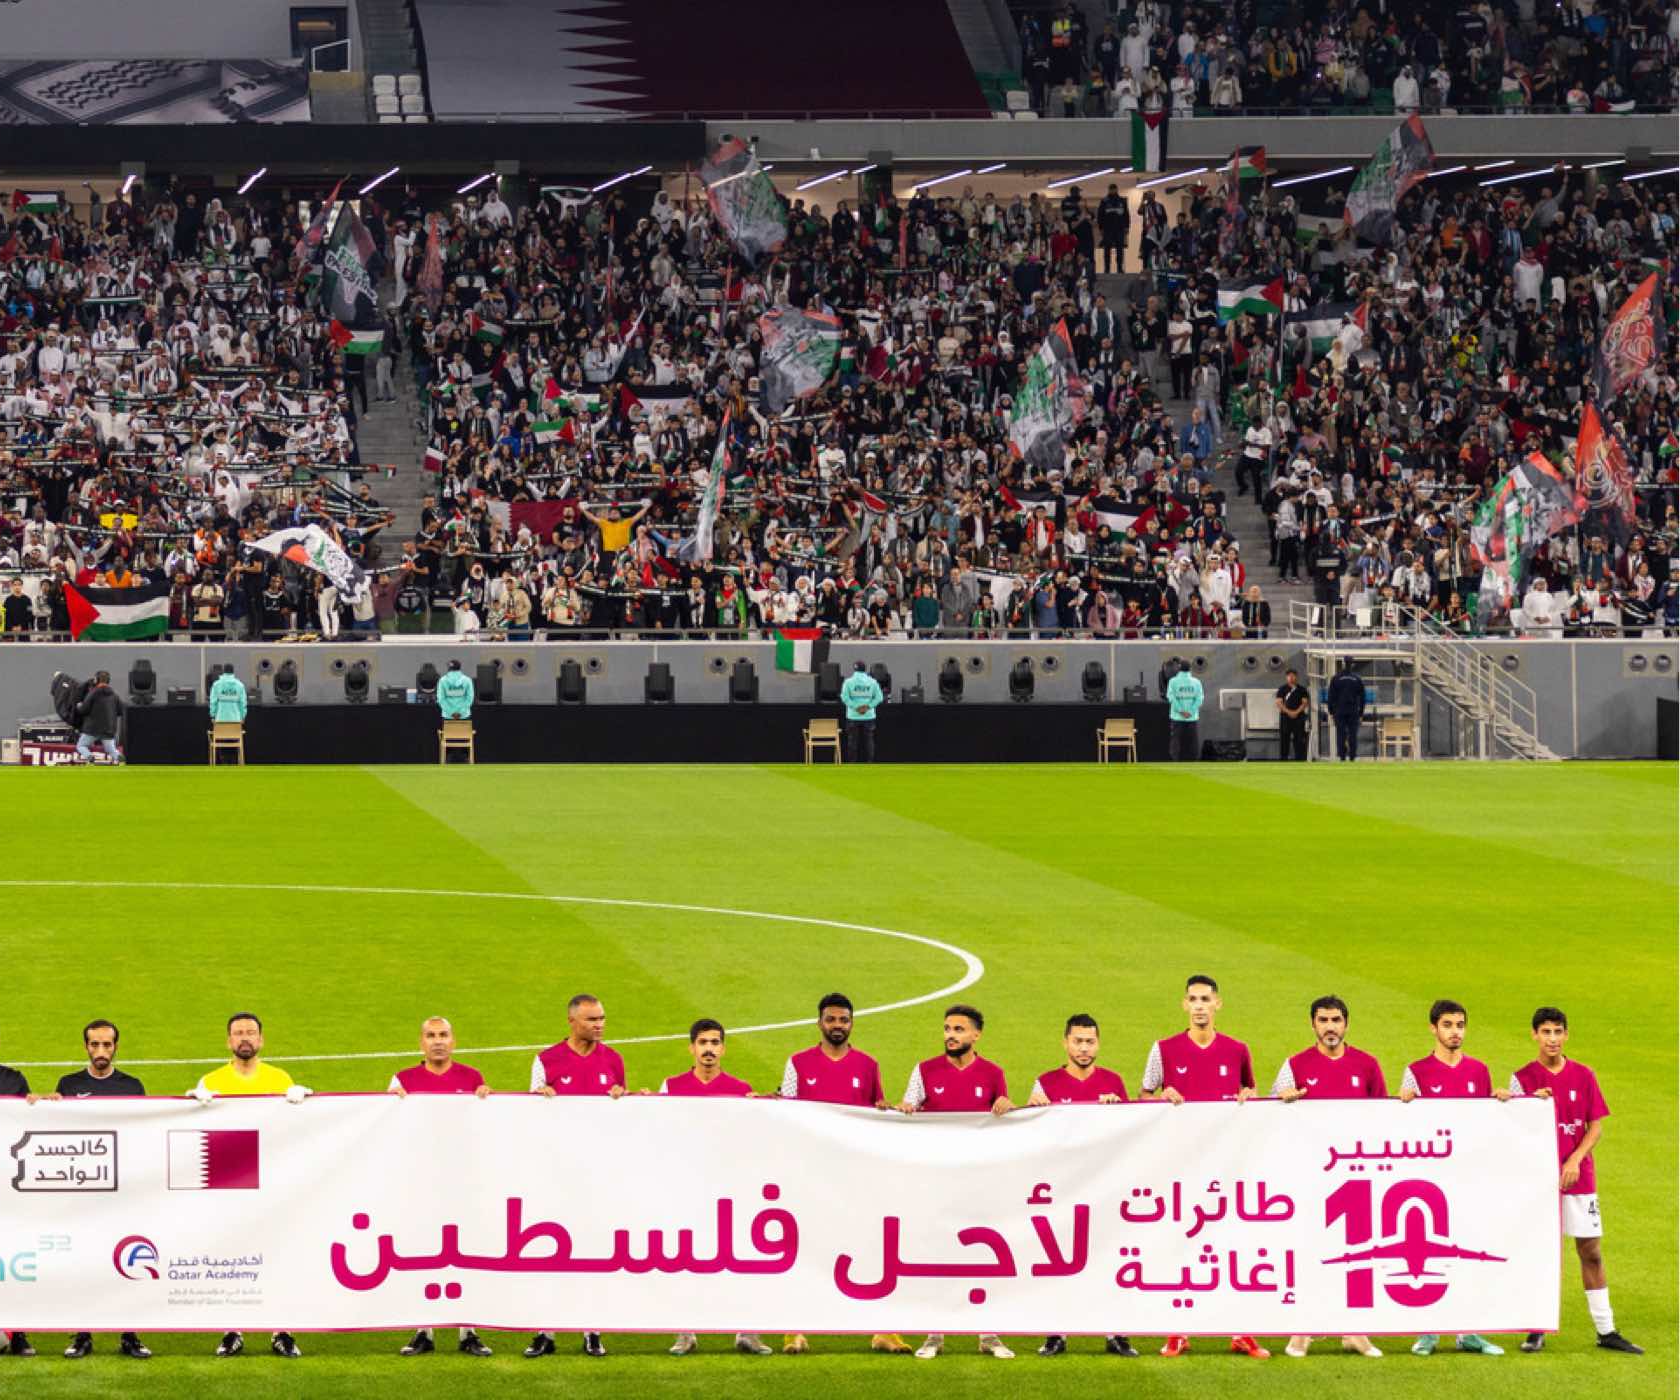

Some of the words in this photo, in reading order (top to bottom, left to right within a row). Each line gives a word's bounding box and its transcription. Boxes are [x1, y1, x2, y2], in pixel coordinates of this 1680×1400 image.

[35, 1138, 108, 1162] كالجسد
[1323, 1129, 1453, 1172] تسيير
[35, 1165, 108, 1186] الواحد
[1120, 1180, 1296, 1238] طائرات
[331, 1184, 800, 1300] فلسطين
[834, 1184, 1091, 1305] لأجل
[168, 1269, 202, 1281] Qatar
[205, 1269, 259, 1282] Academy
[1115, 1244, 1296, 1309] إغاثية
